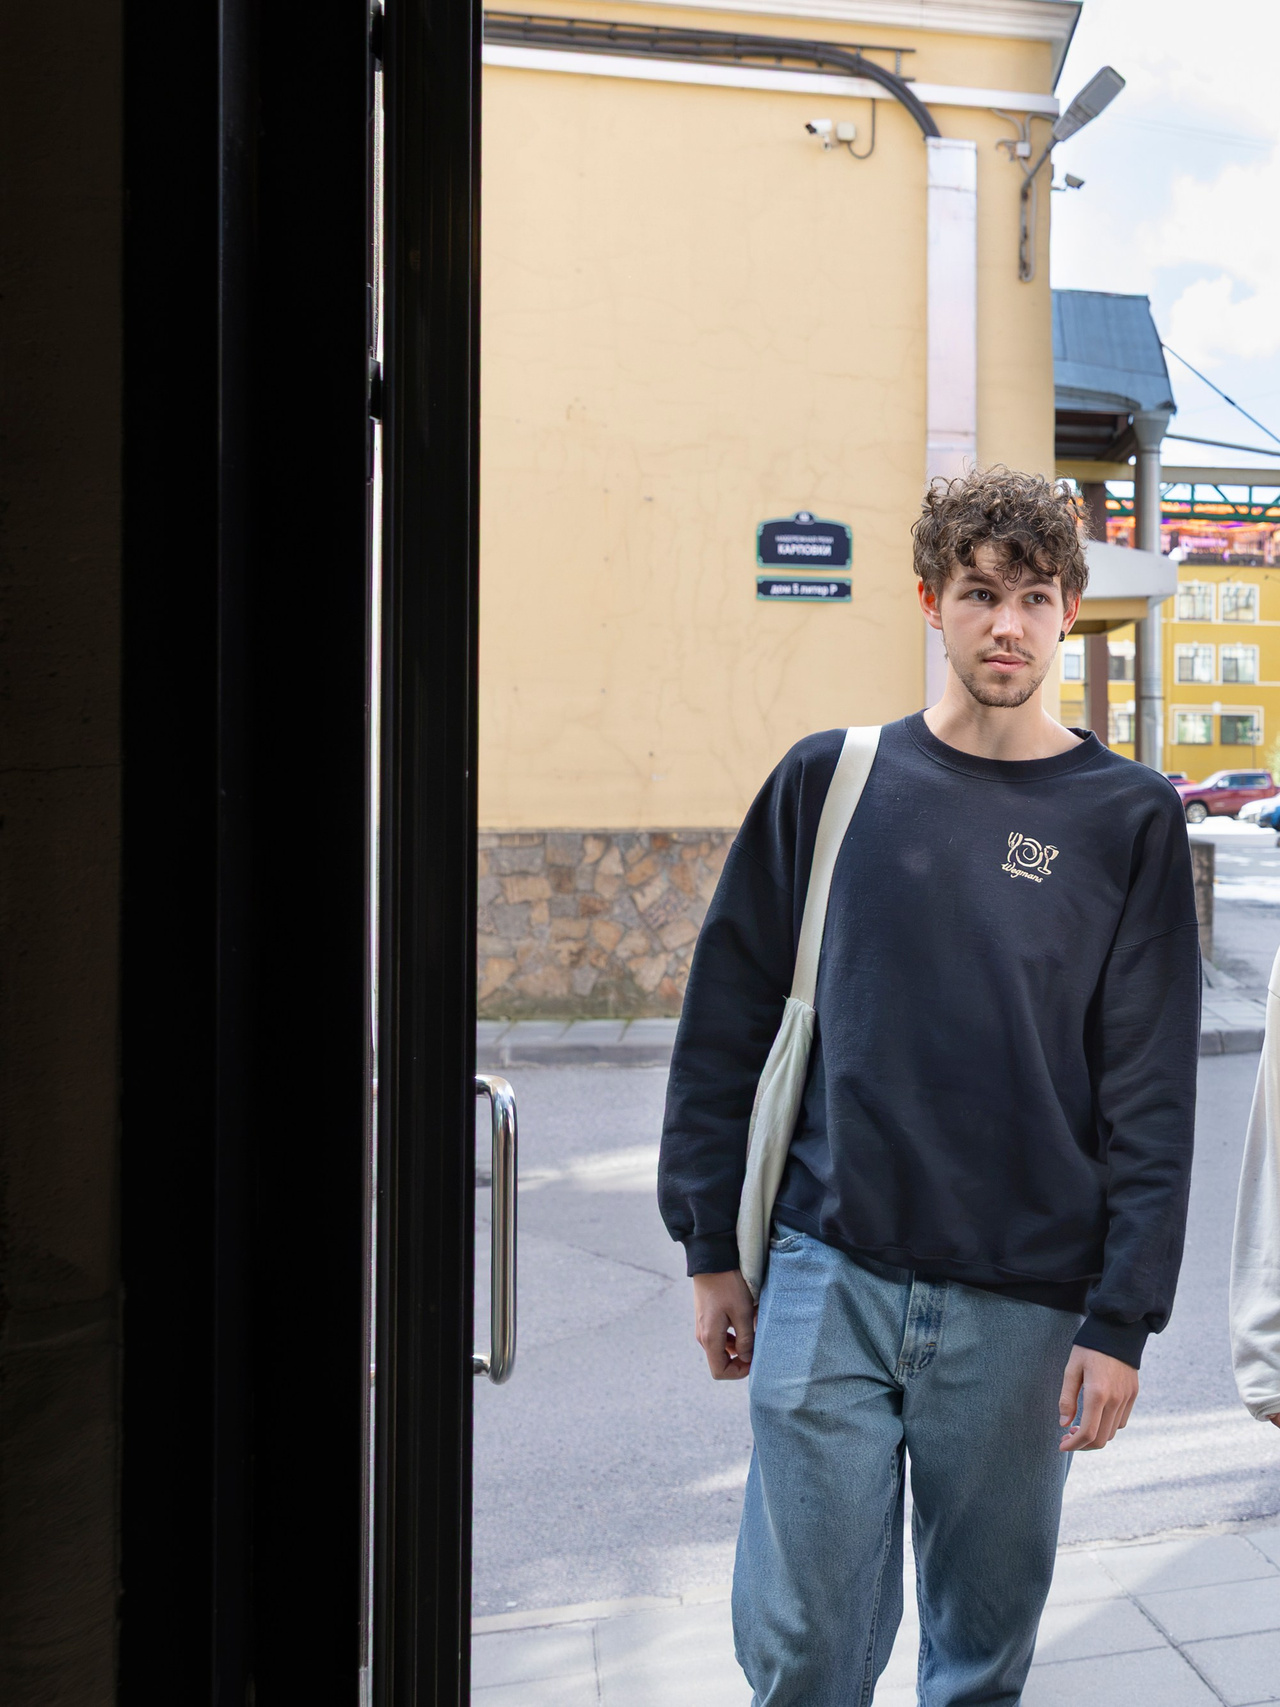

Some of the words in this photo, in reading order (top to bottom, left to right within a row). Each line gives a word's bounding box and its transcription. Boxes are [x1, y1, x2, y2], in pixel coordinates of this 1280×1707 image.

[777, 543, 832, 556] КАРПОВКИ
[770, 584, 791, 595] дом
[800, 585, 829, 597] литер
[829, 583, 838, 595] Р
[1001, 862, 1043, 883] Wegmans
